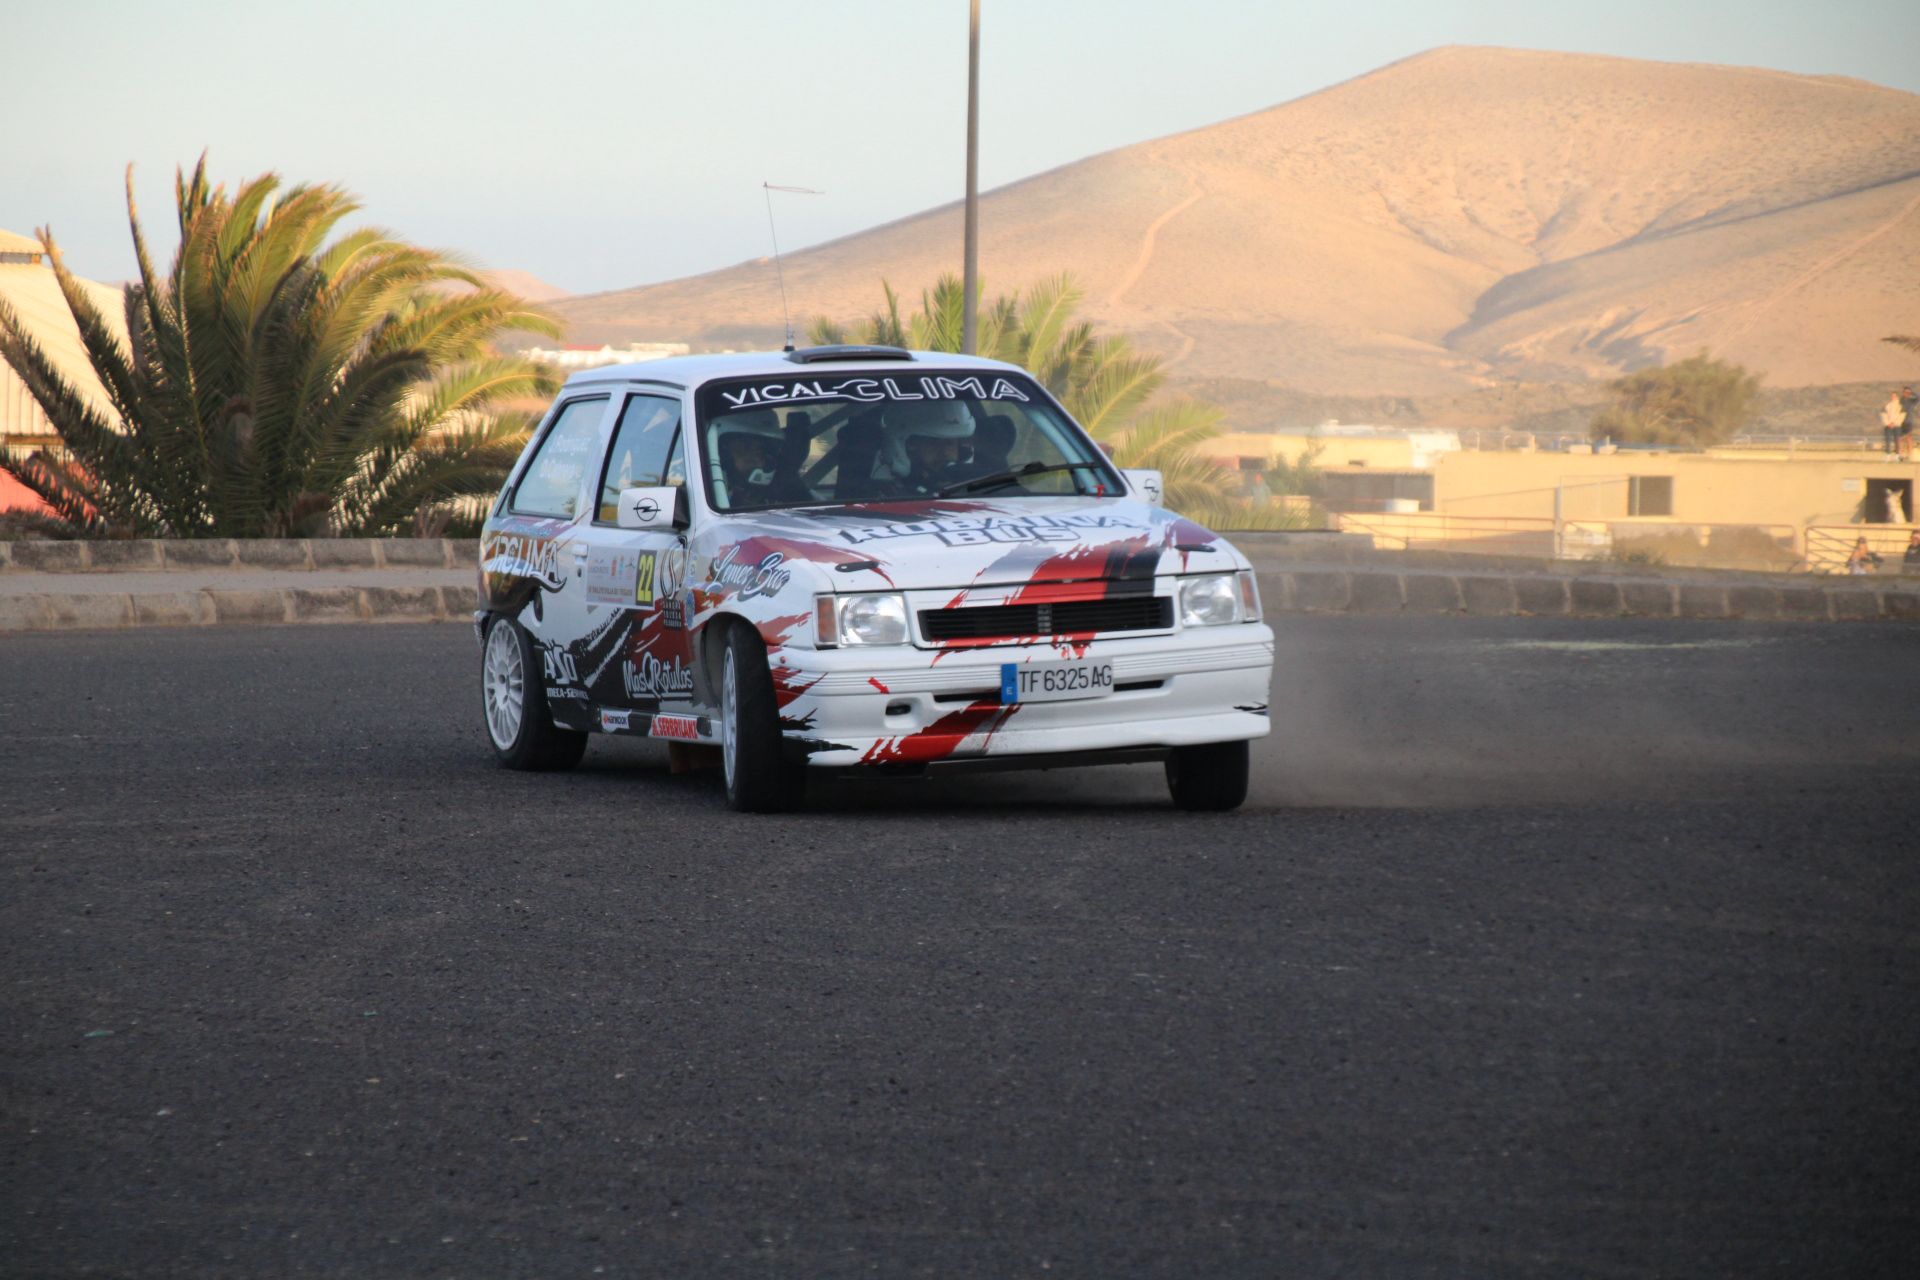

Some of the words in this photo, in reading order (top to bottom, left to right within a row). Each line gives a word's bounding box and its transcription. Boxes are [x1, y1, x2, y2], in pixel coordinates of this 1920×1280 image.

[723, 380, 838, 405] VICAL
[839, 376, 1030, 402] CLIMA
[838, 514, 1140, 544] ROBAINA
[936, 526, 1081, 548] BUS
[637, 554, 654, 602] 22
[1006, 686, 1013, 695] E
